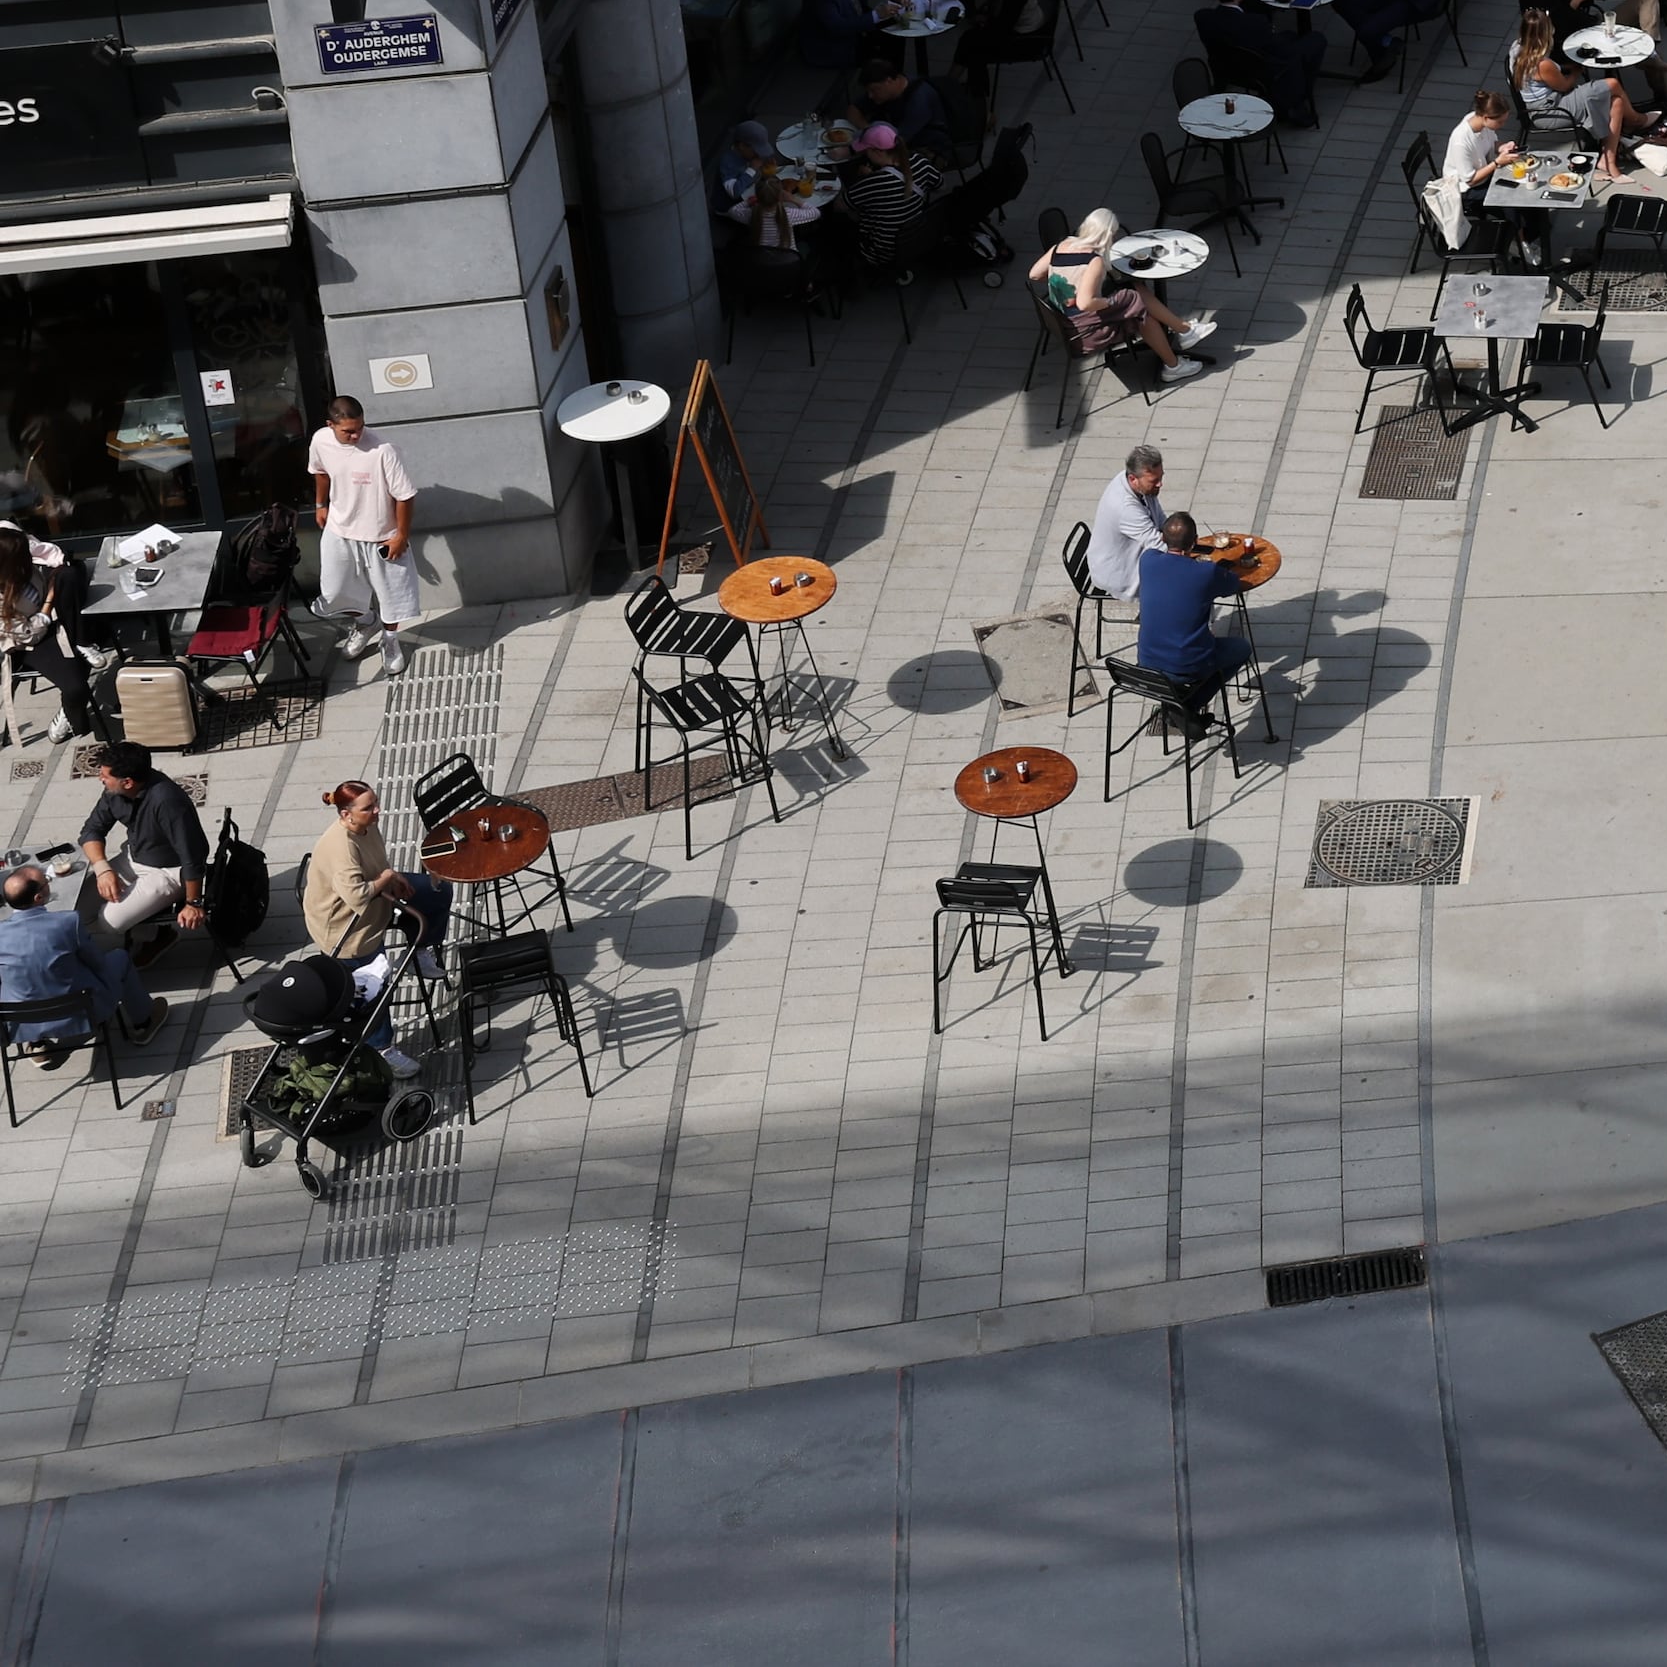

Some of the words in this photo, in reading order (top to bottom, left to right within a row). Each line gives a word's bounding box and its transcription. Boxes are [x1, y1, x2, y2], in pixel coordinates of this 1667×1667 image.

[326, 40, 340, 51] D'
[344, 32, 431, 51] AUDERGHEM
[333, 45, 428, 64] OUDERGEMSE
[0, 97, 40, 127] es
